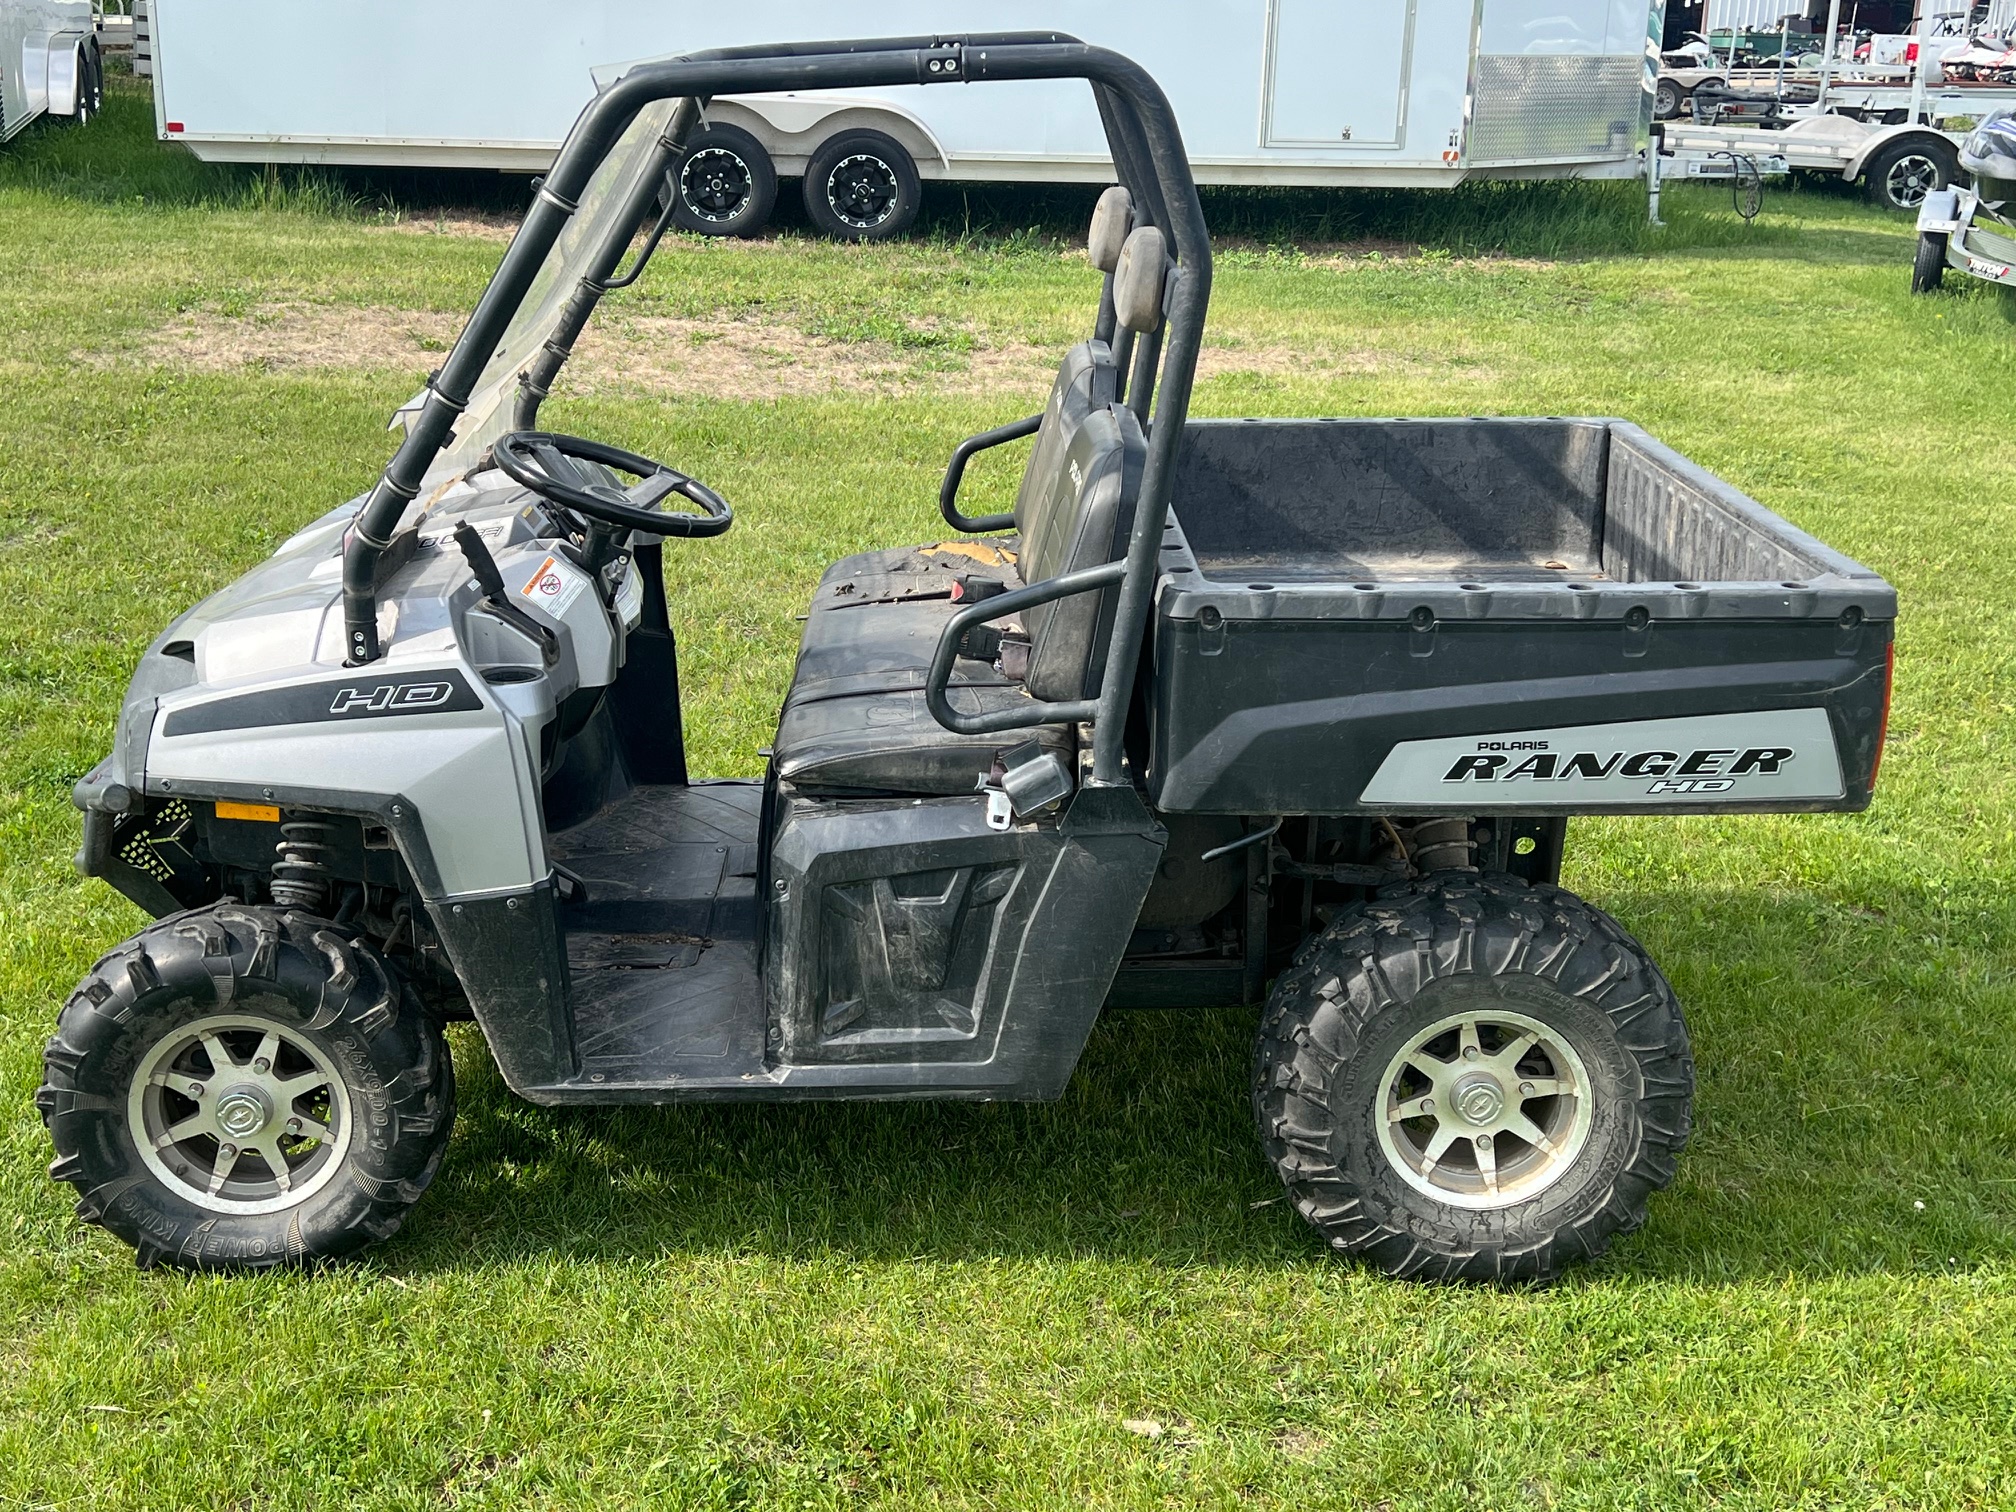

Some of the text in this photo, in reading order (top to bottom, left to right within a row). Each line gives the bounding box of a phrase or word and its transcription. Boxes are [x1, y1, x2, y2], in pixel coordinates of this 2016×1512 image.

[329, 681, 453, 713] HD
[1477, 741, 1549, 751] POLARIS
[1441, 747, 1795, 782] RANGER
[1646, 778, 1736, 795] HD
[117, 1193, 286, 1259] POWER KING
